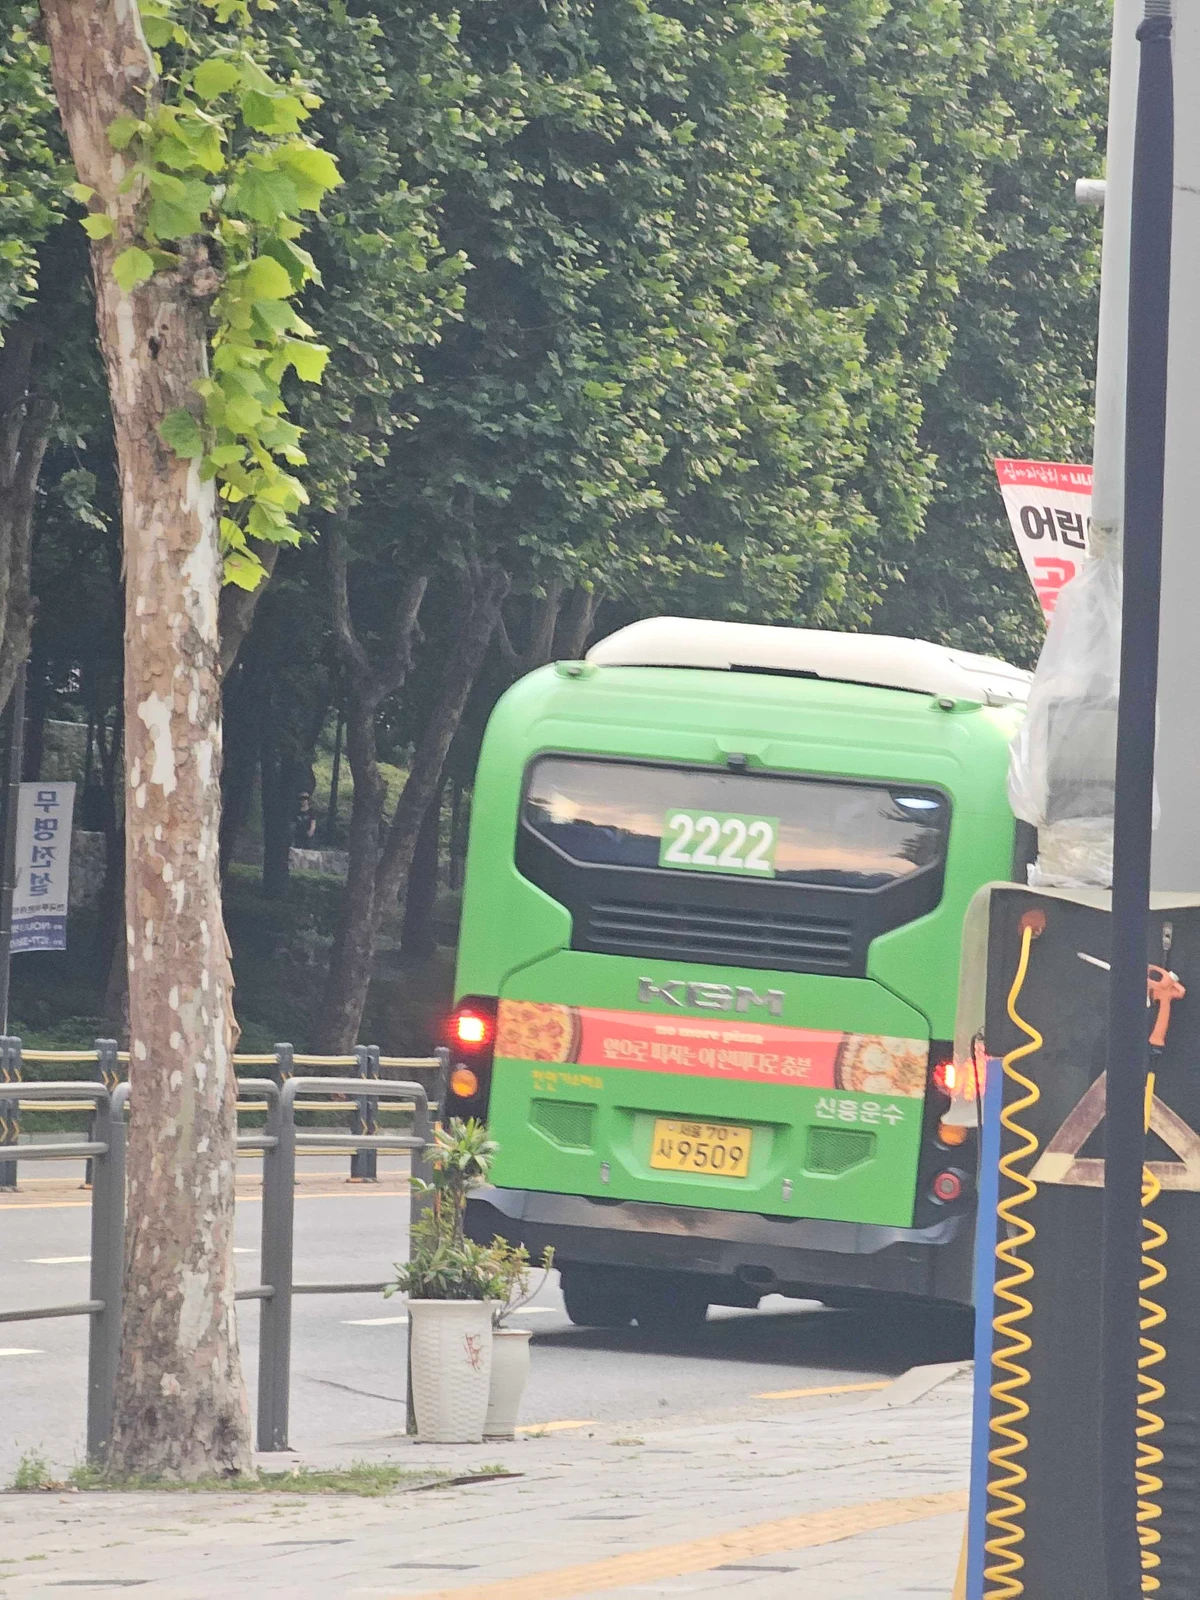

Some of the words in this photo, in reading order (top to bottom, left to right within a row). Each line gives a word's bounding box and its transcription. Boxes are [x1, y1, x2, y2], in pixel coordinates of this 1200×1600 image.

[1020, 505, 1091, 550] 어린
[664, 814, 774, 871] 2222
[638, 976, 786, 1017] KGM
[814, 1096, 905, 1125] 신흥운수
[706, 1126, 729, 1141] 70
